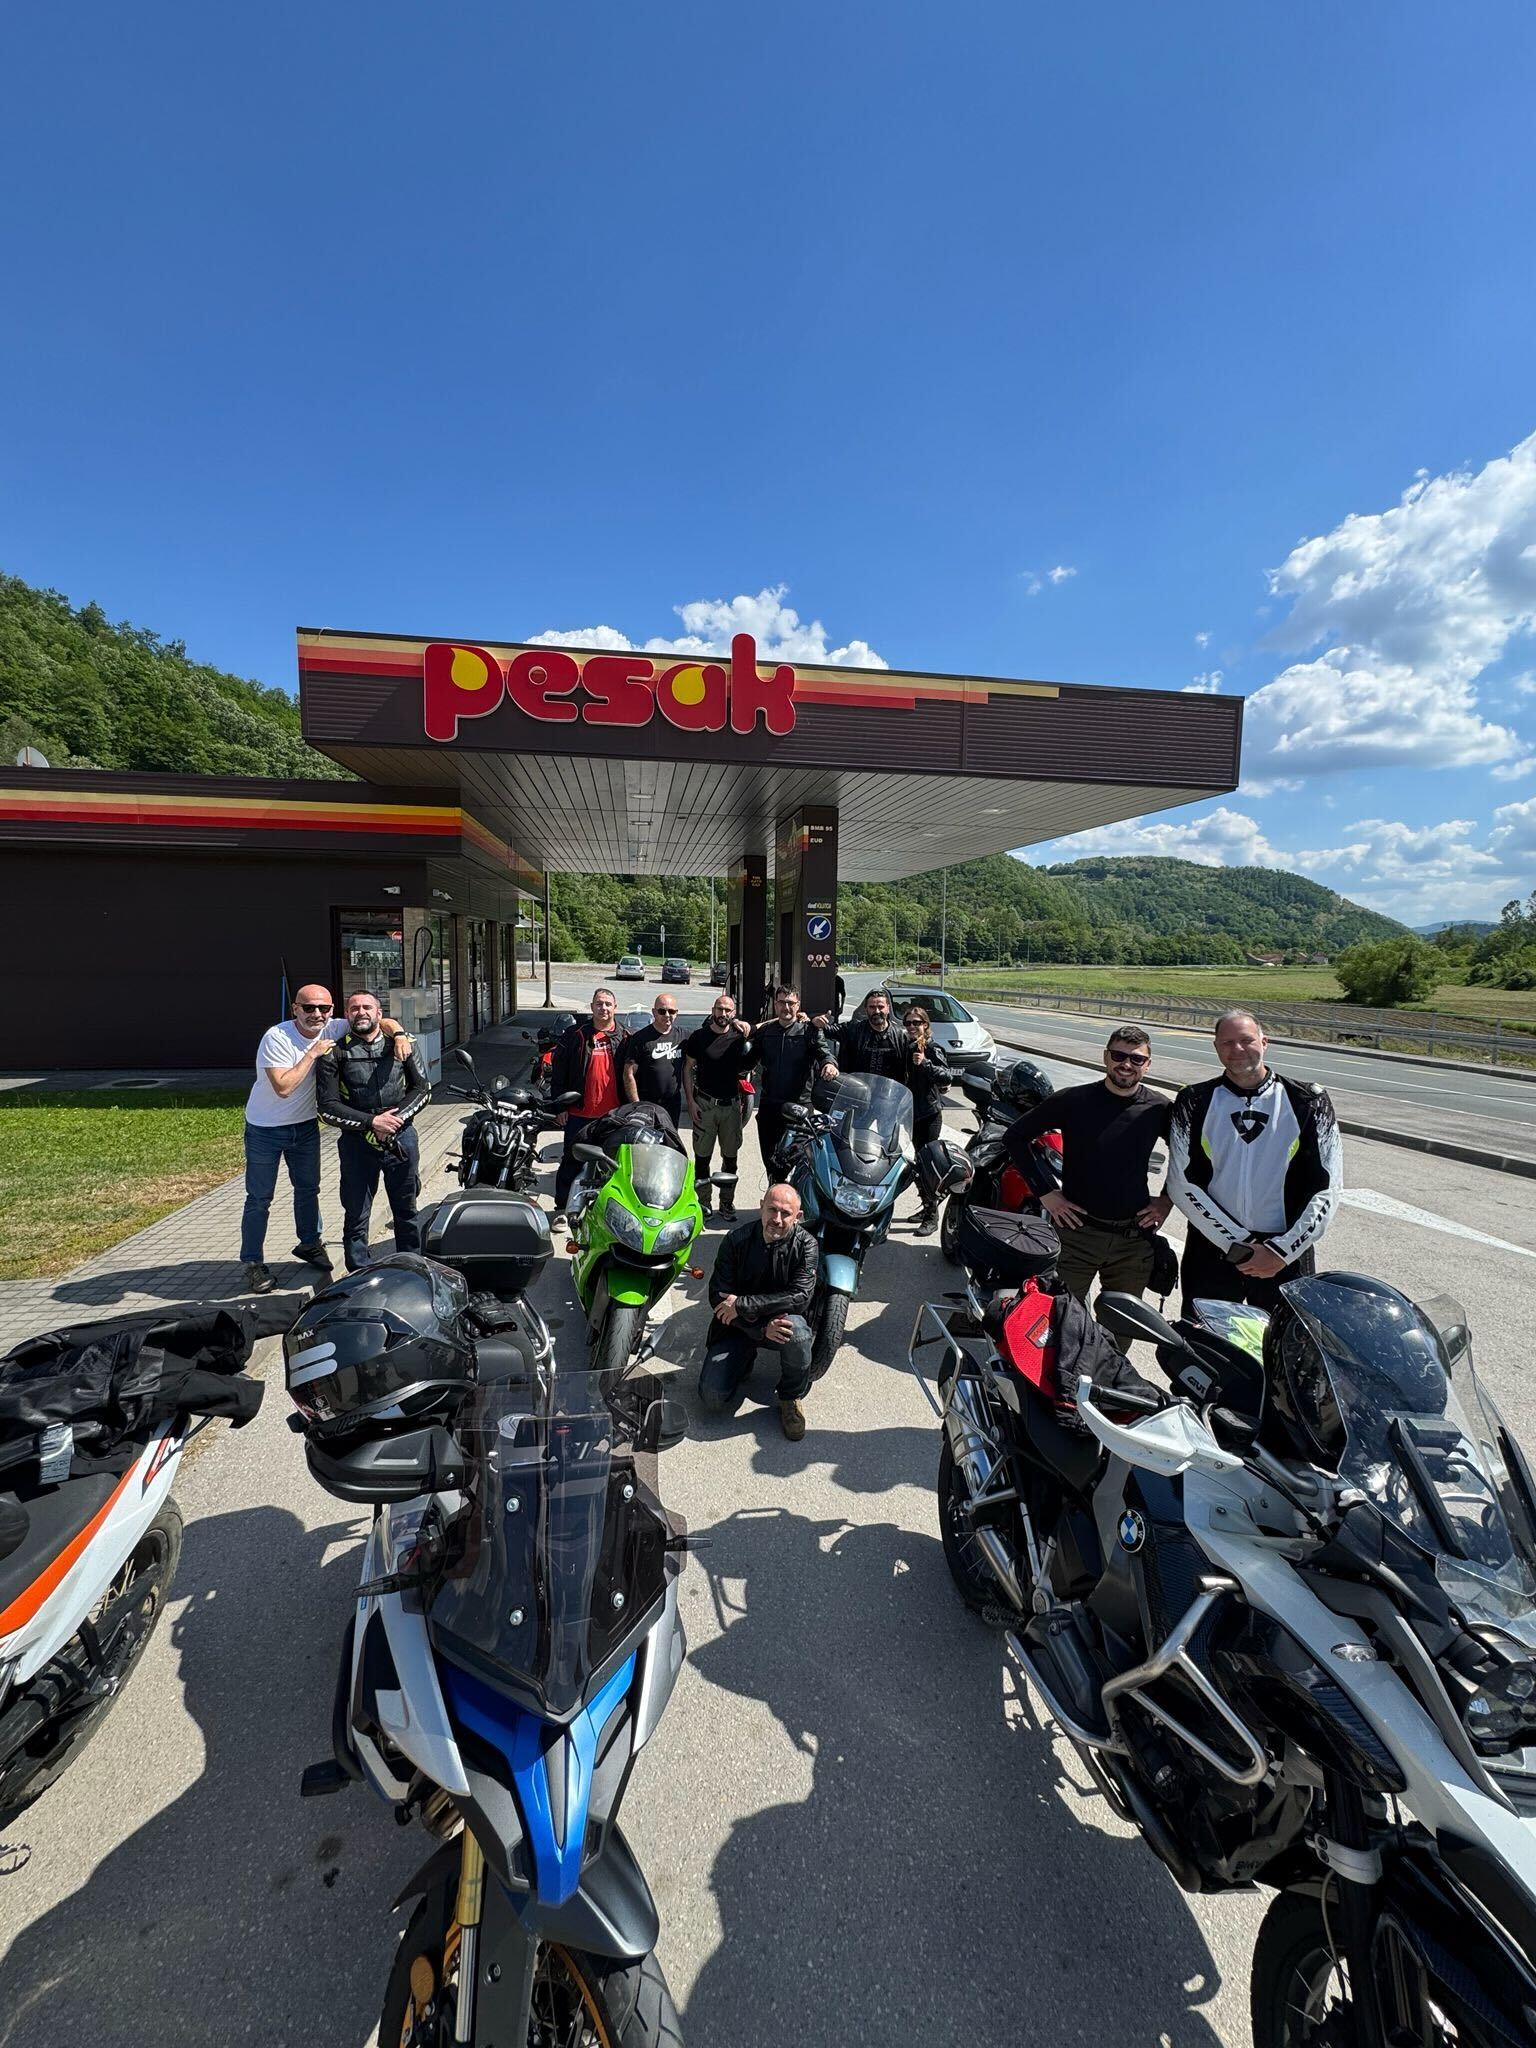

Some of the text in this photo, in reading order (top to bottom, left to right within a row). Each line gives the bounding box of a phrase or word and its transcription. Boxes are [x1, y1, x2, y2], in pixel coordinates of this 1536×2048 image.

[424, 633, 796, 742] pesak
[656, 1042, 672, 1051] JUST
[1184, 1192, 1236, 1241] REV'IT!
[1290, 1199, 1331, 1252] REV'IT!
